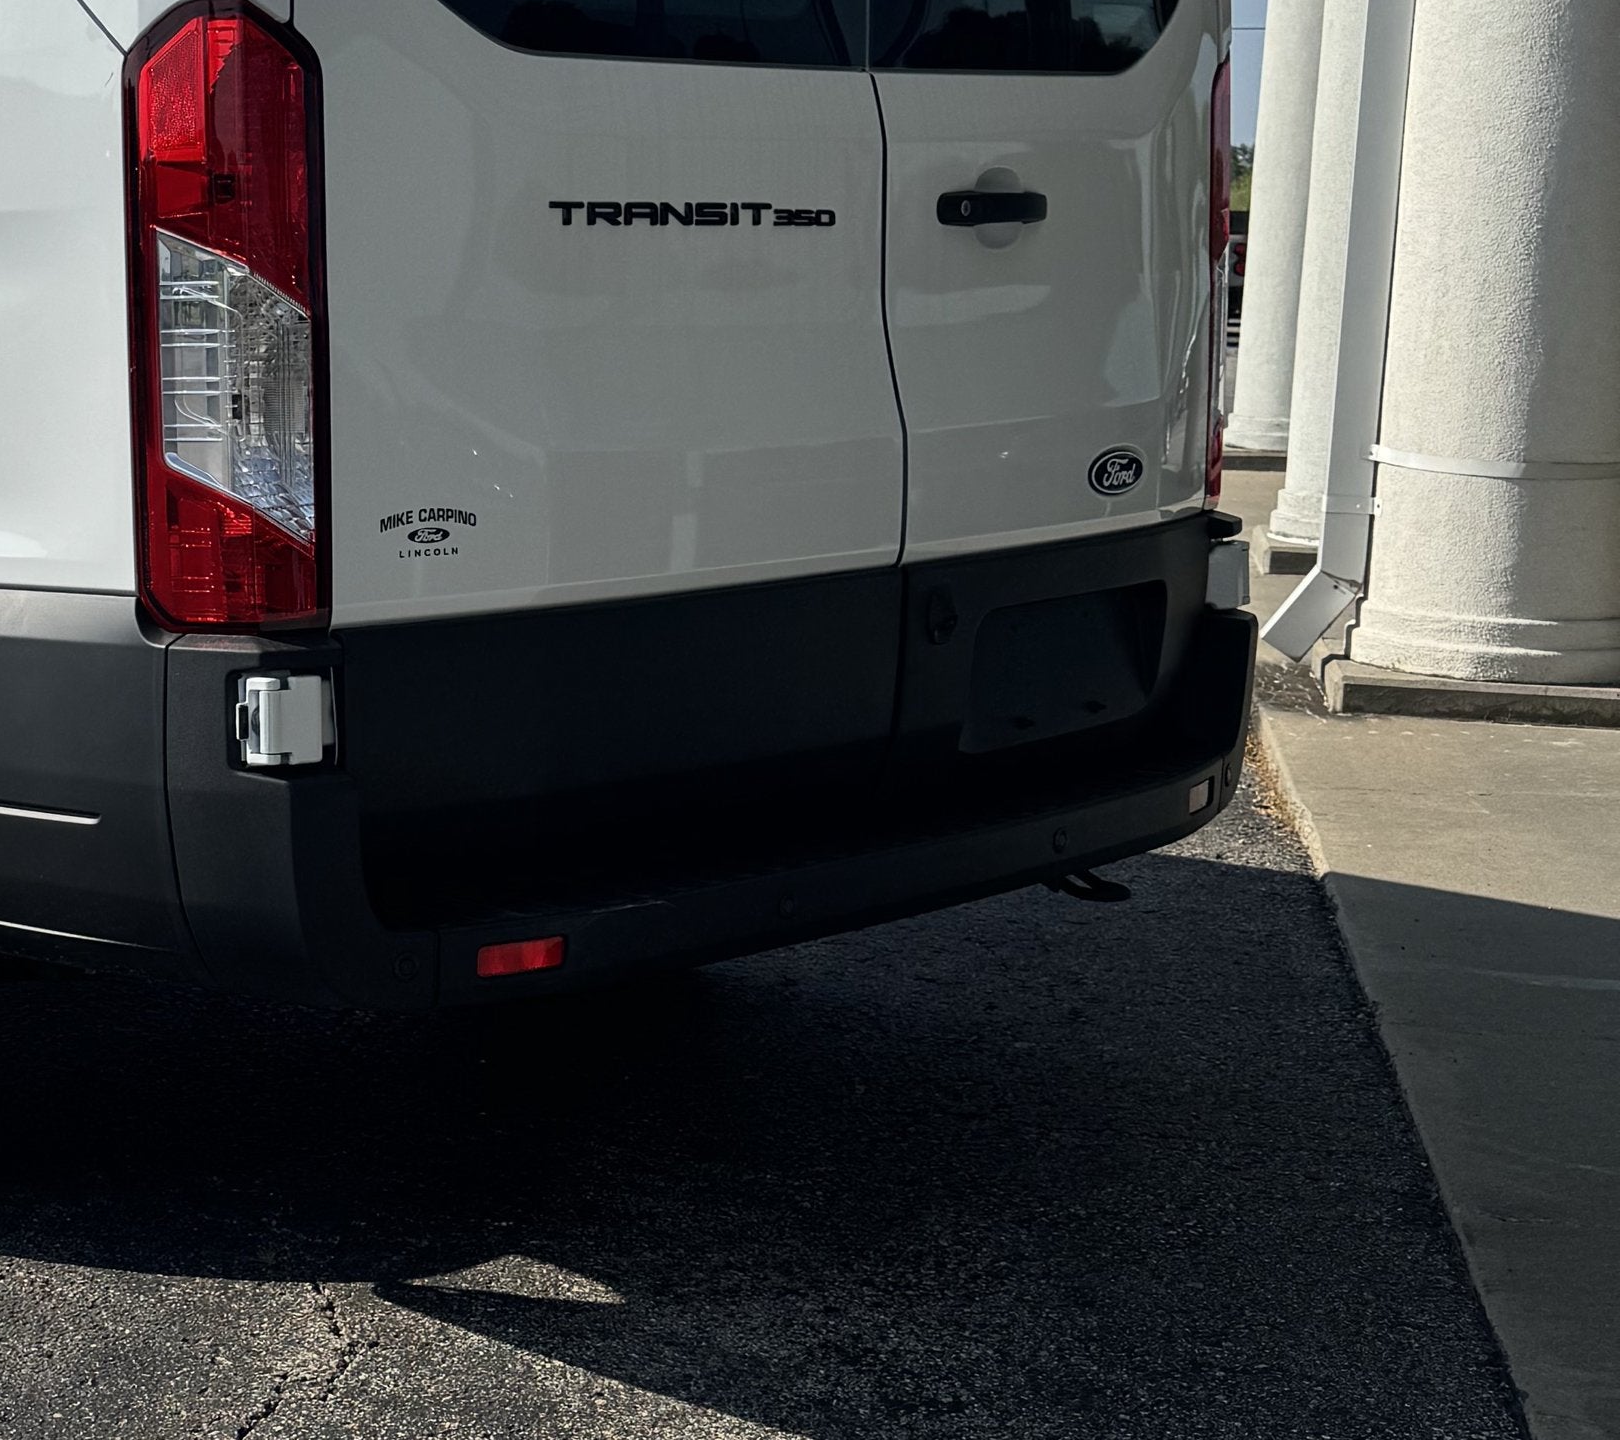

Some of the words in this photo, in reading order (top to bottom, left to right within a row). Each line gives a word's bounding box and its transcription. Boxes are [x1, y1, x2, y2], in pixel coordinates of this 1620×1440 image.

[548, 201, 772, 226] TRANSIT
[773, 209, 836, 227] 350
[1102, 458, 1136, 487] Ford
[380, 510, 414, 533] MIKE
[418, 507, 477, 527] CARPINO
[414, 528, 443, 542] Ford
[399, 547, 459, 558] LINCOLN
